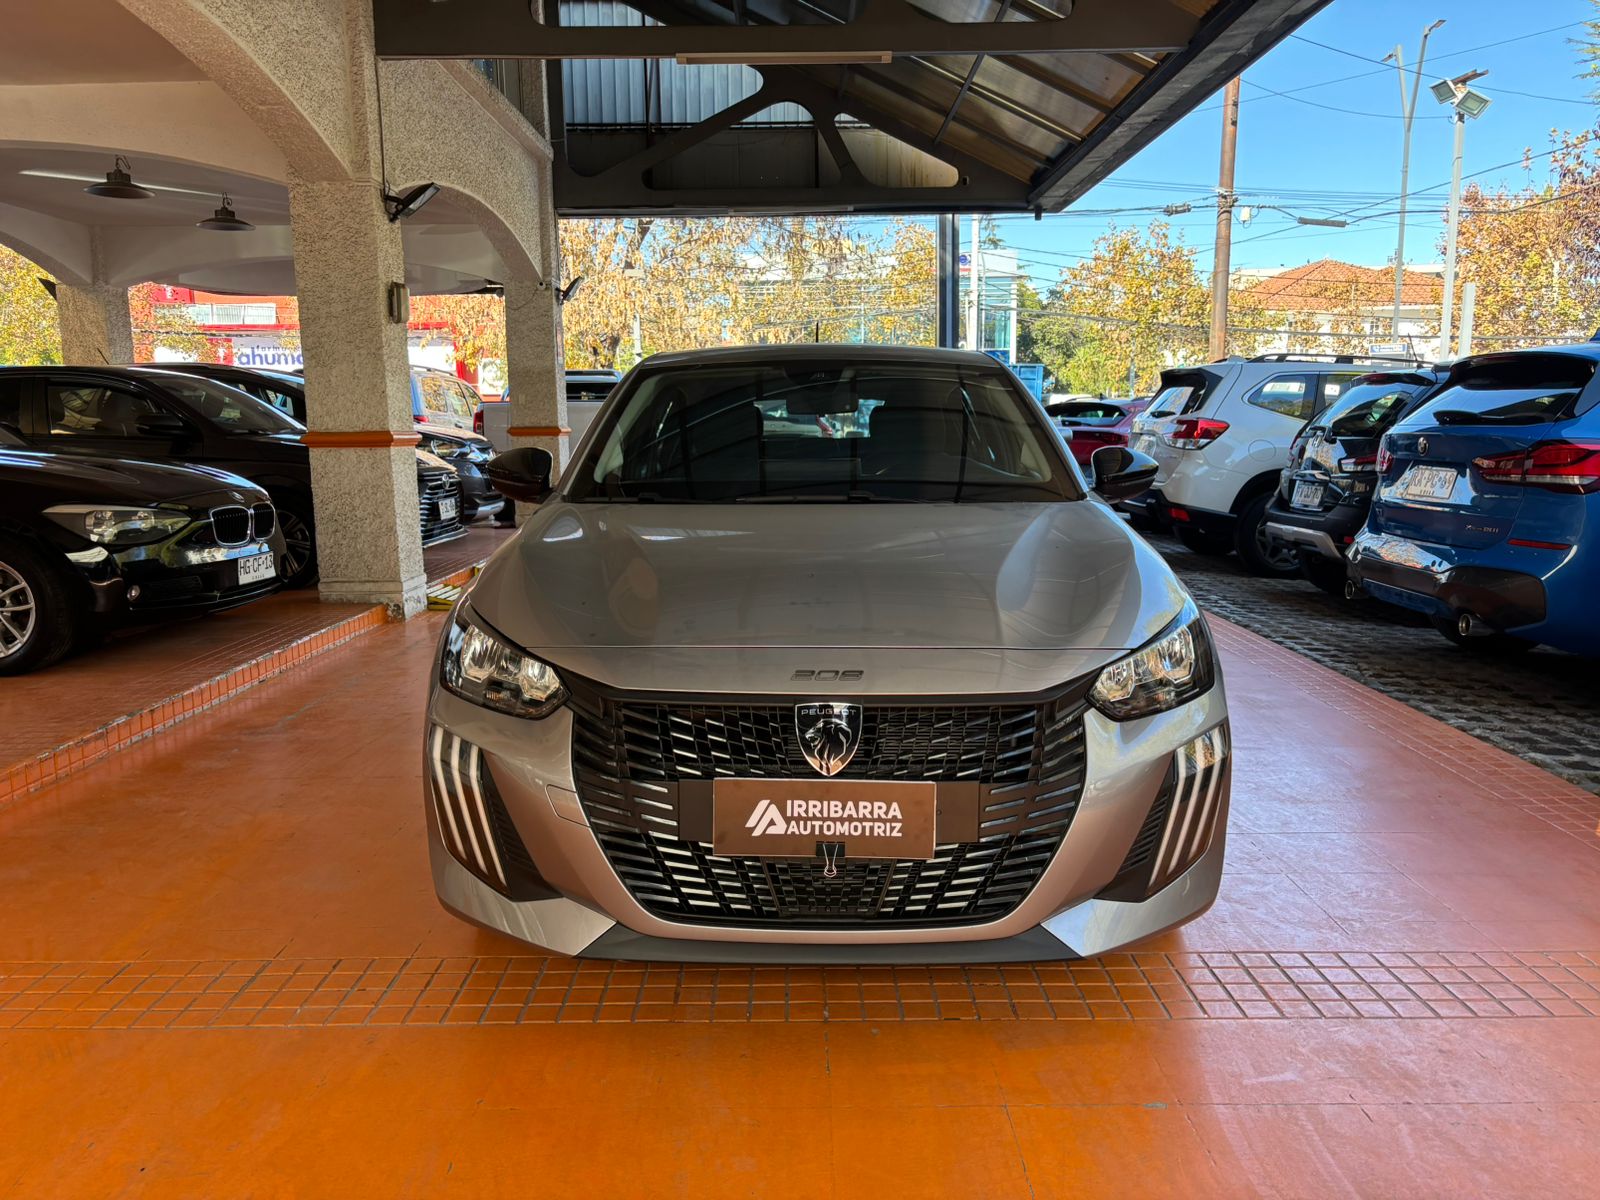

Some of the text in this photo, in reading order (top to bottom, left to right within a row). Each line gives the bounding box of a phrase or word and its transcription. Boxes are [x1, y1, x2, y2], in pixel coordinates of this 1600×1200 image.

[790, 669, 864, 681] 208
[801, 708, 856, 716] PEUGEOT
[786, 799, 902, 819] IRRIBARRA
[786, 820, 902, 837] AUTOMOTRIZ
